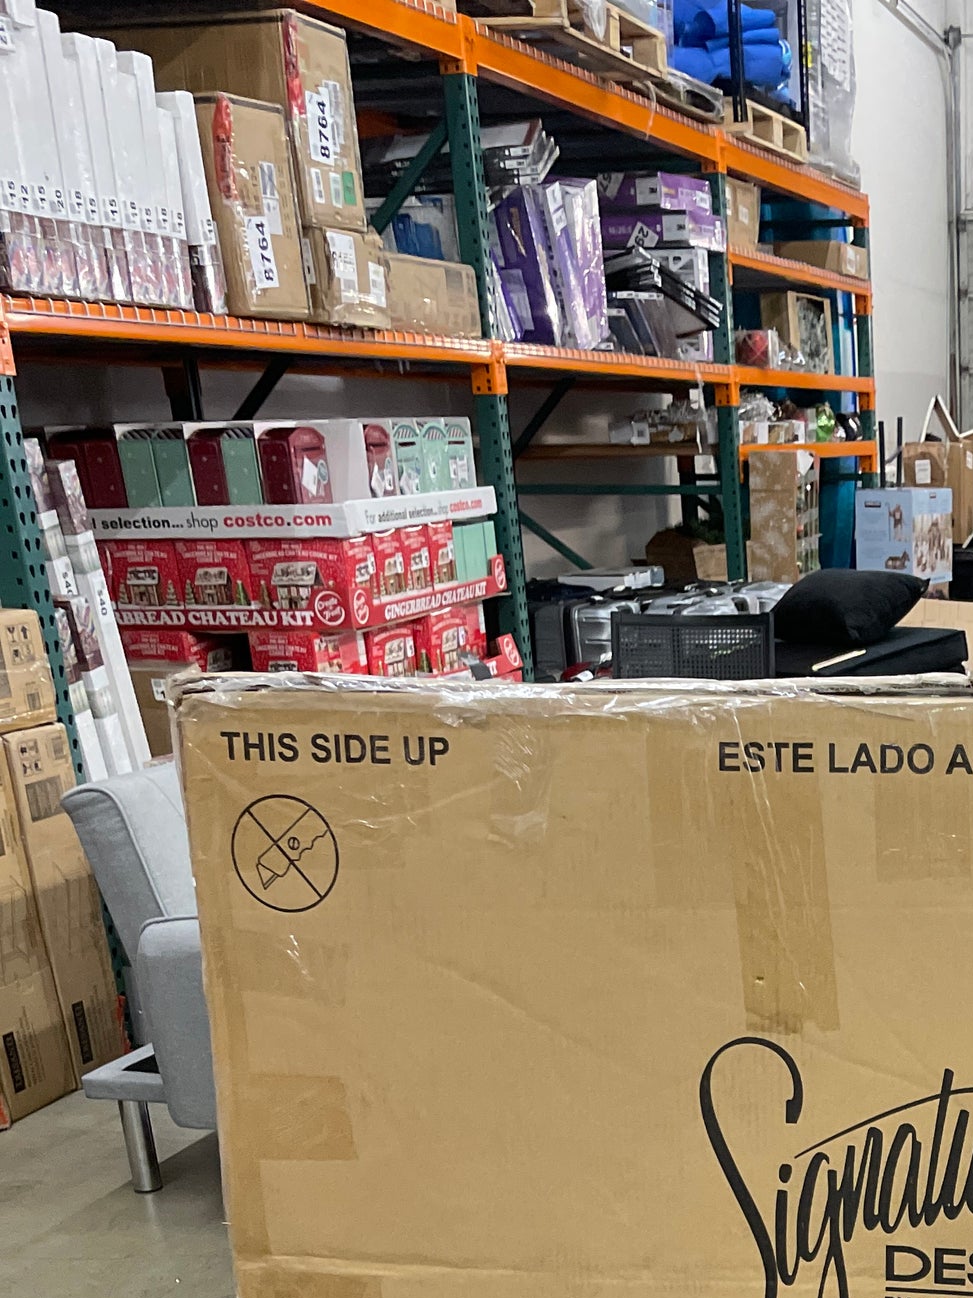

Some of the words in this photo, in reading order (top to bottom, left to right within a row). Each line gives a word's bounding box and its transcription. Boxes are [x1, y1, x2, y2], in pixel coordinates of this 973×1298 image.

[318, 100, 331, 159] 8764
[255, 221, 274, 282] 8764
[186, 512, 219, 532] shop
[224, 512, 332, 528] costco.com
[384, 592, 441, 620] GINGERBREAD
[442, 585, 474, 606] CHATEAU
[475, 582, 487, 599] KIT
[188, 610, 278, 626] CHATEAU
[282, 612, 314, 626] KIT
[220, 732, 299, 762] THIS
[311, 733, 391, 765] SIDE
[404, 736, 450, 765] UP
[718, 742, 814, 773] ESTE
[829, 743, 934, 774] LADO
